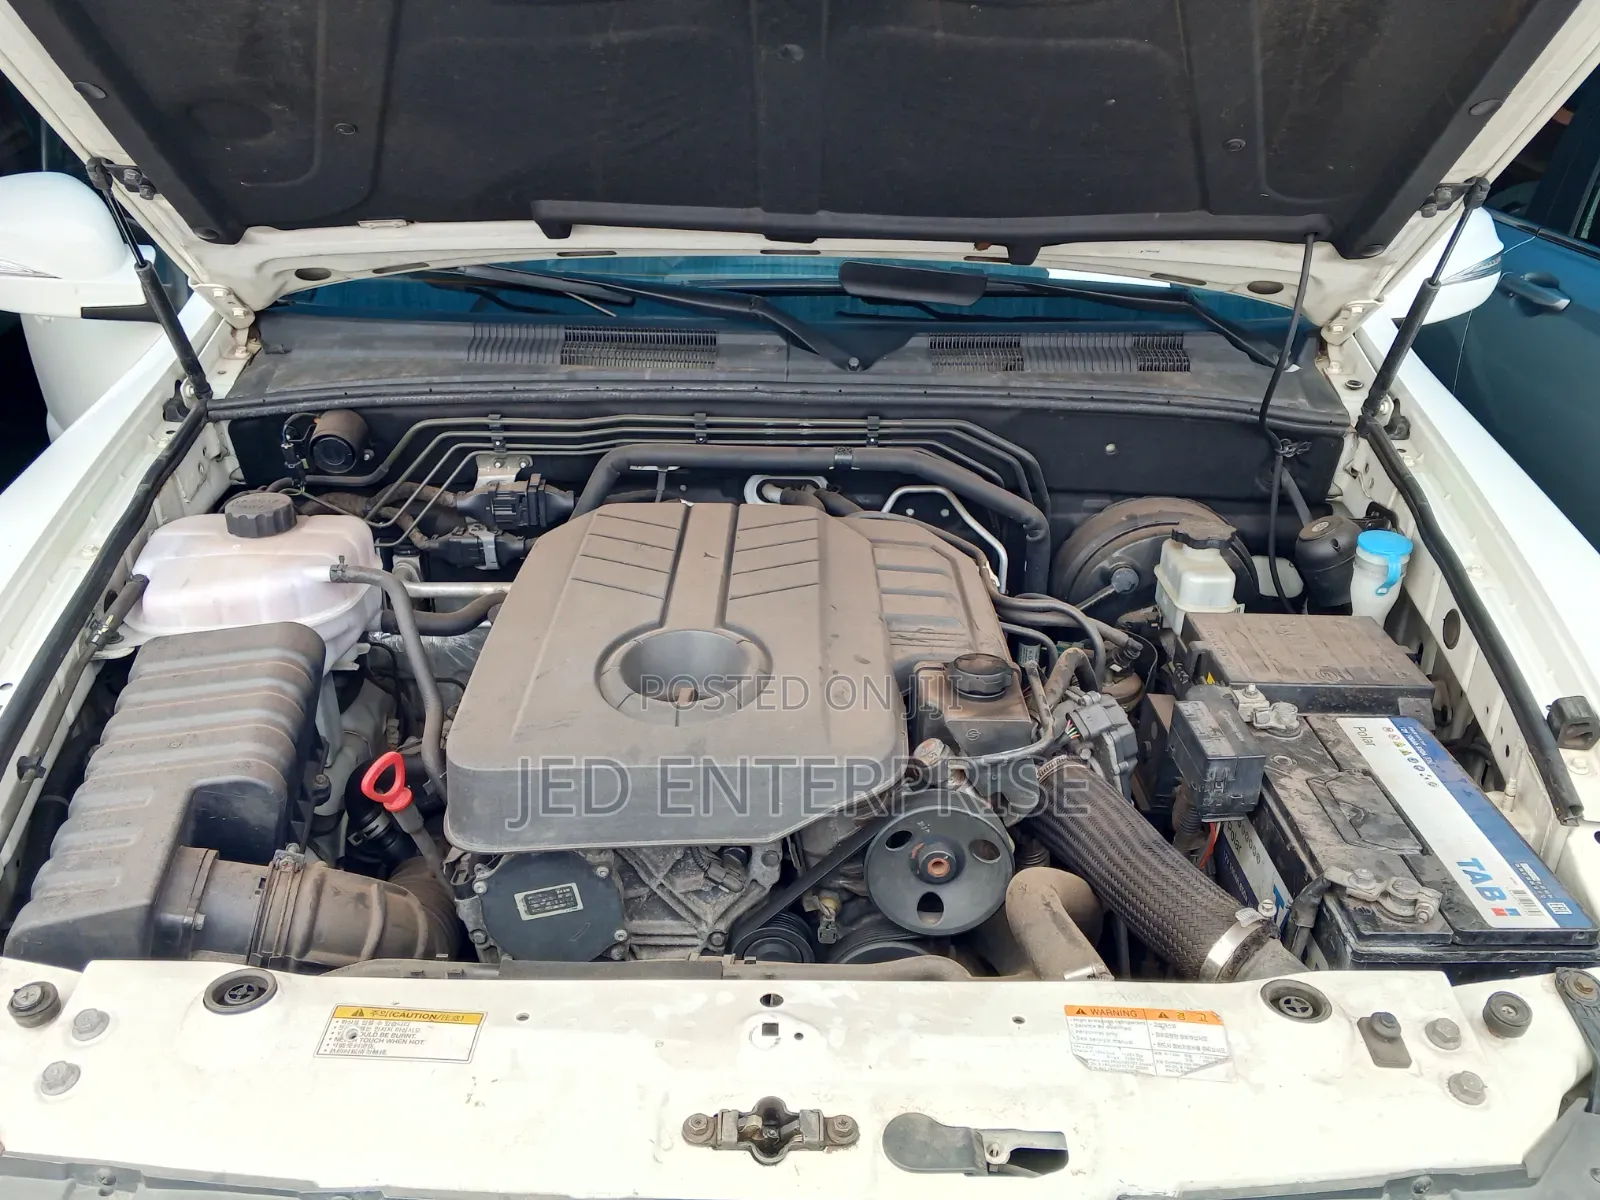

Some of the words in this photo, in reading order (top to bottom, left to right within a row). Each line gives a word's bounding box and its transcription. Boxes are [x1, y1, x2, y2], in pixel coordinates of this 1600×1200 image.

[1353, 726, 1376, 746] Polar
[1456, 857, 1507, 901] TAB
[1090, 1008, 1138, 1018] WARNING
